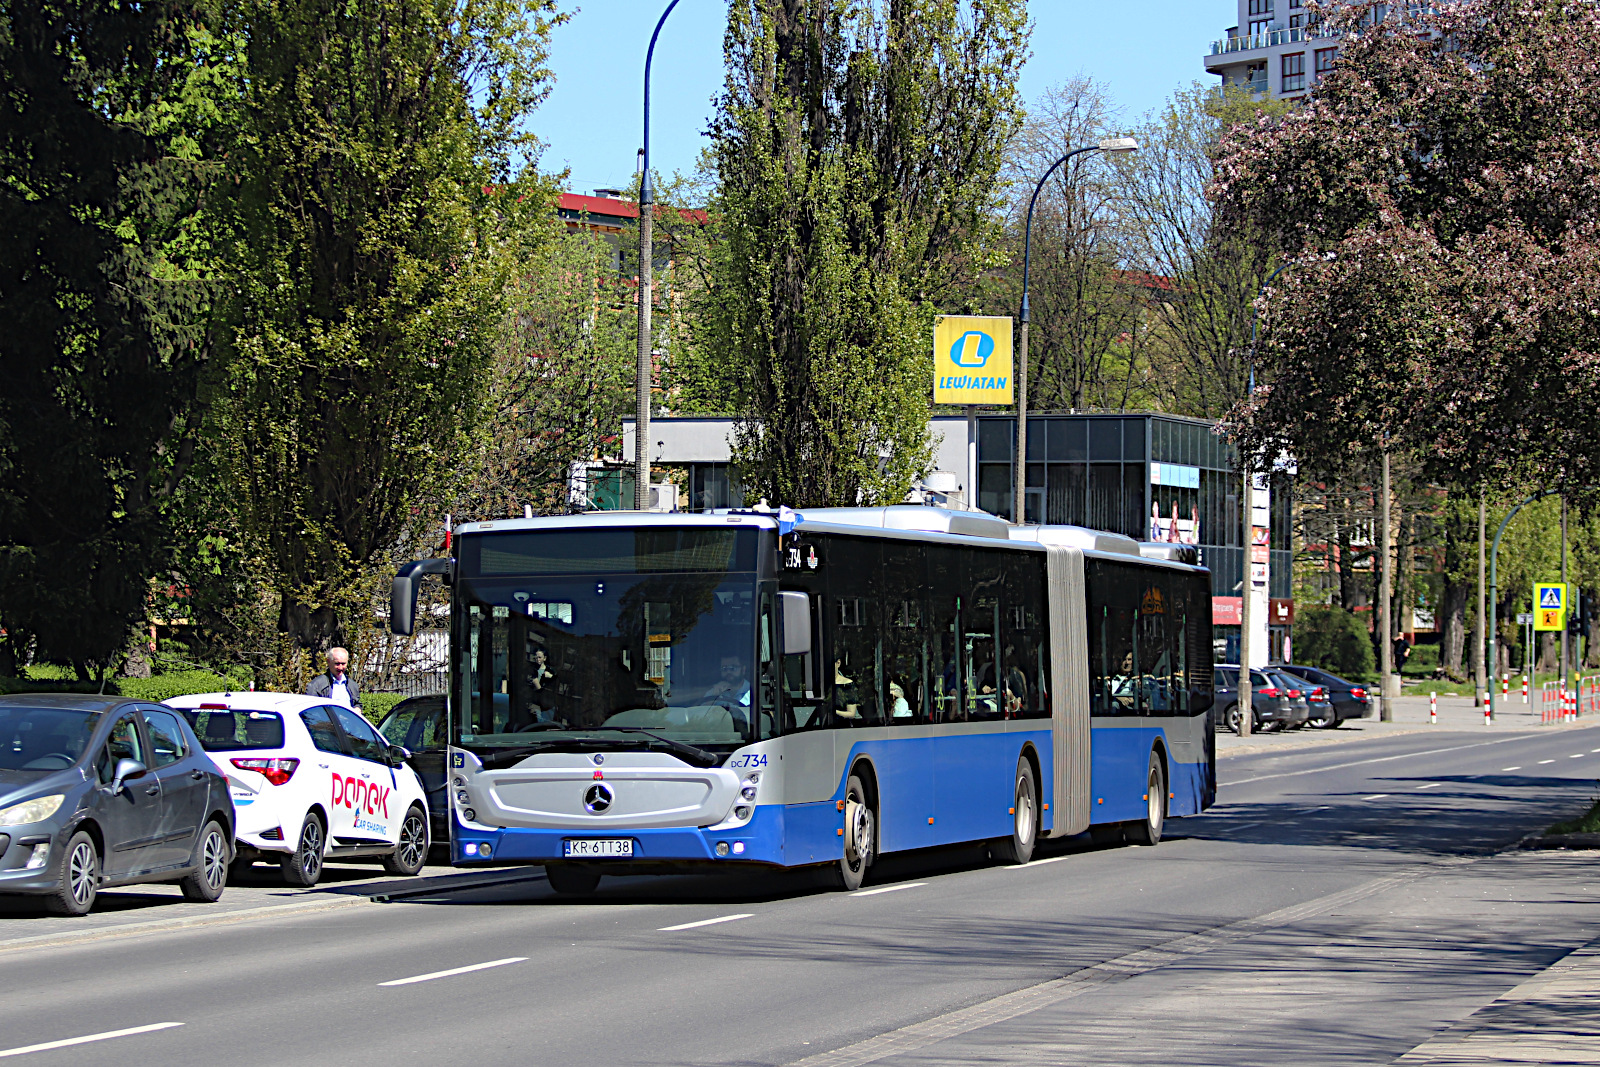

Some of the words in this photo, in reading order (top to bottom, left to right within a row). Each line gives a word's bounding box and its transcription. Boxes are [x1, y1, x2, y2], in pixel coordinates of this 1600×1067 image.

[939, 375, 1007, 389] LEWIATAN
[356, 819, 366, 830] CAR
[366, 821, 387, 835] SHARING
[572, 841, 588, 853] KR
[592, 841, 630, 853] 6TT38
